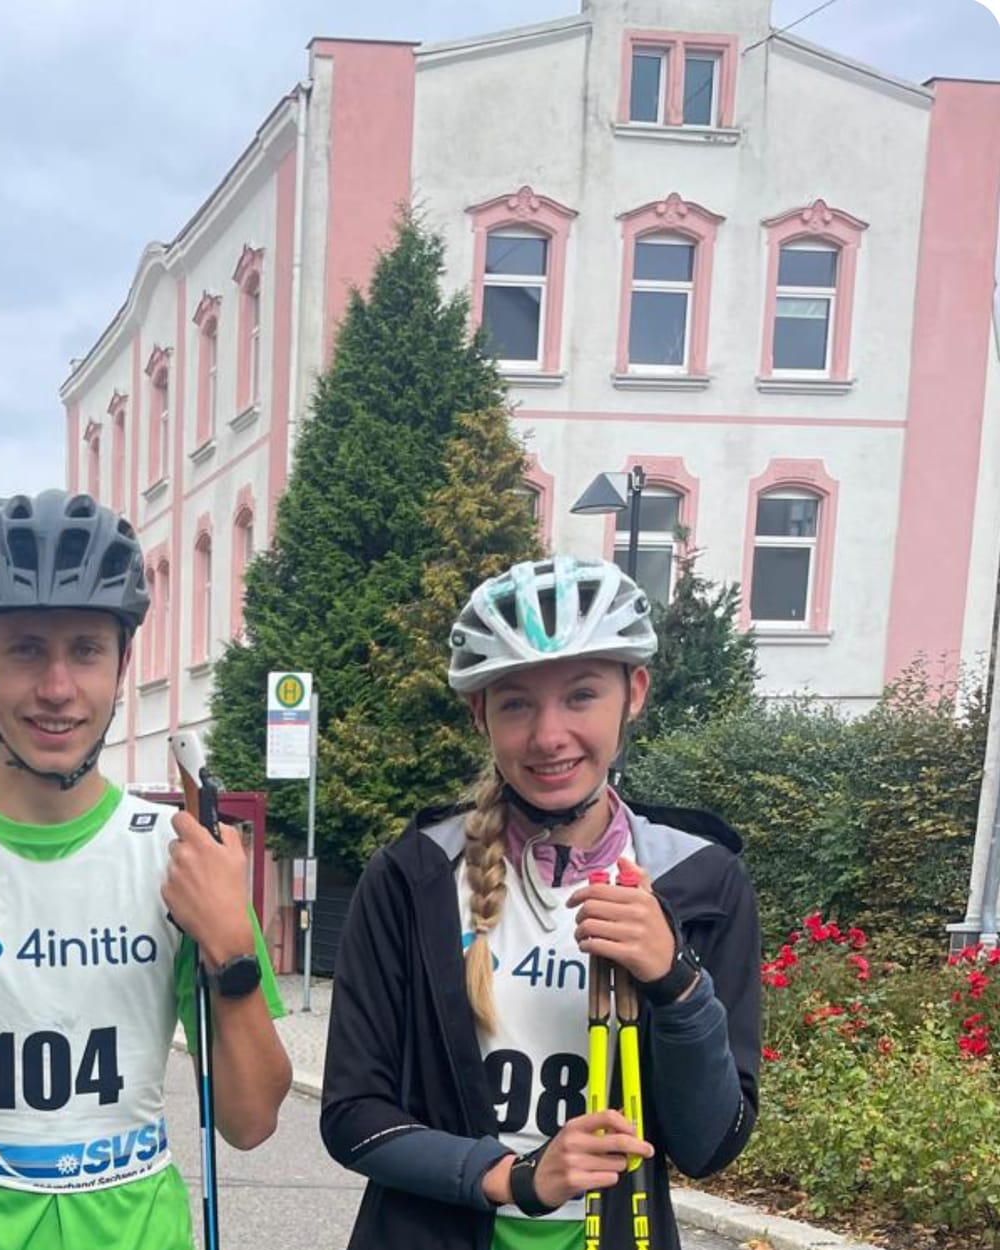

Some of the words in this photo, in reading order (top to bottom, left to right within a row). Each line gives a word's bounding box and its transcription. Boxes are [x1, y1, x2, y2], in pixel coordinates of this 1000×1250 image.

[16, 926, 158, 967] 4initia
[484, 1049, 589, 1138] 98
[82, 1125, 159, 1175] SVS
